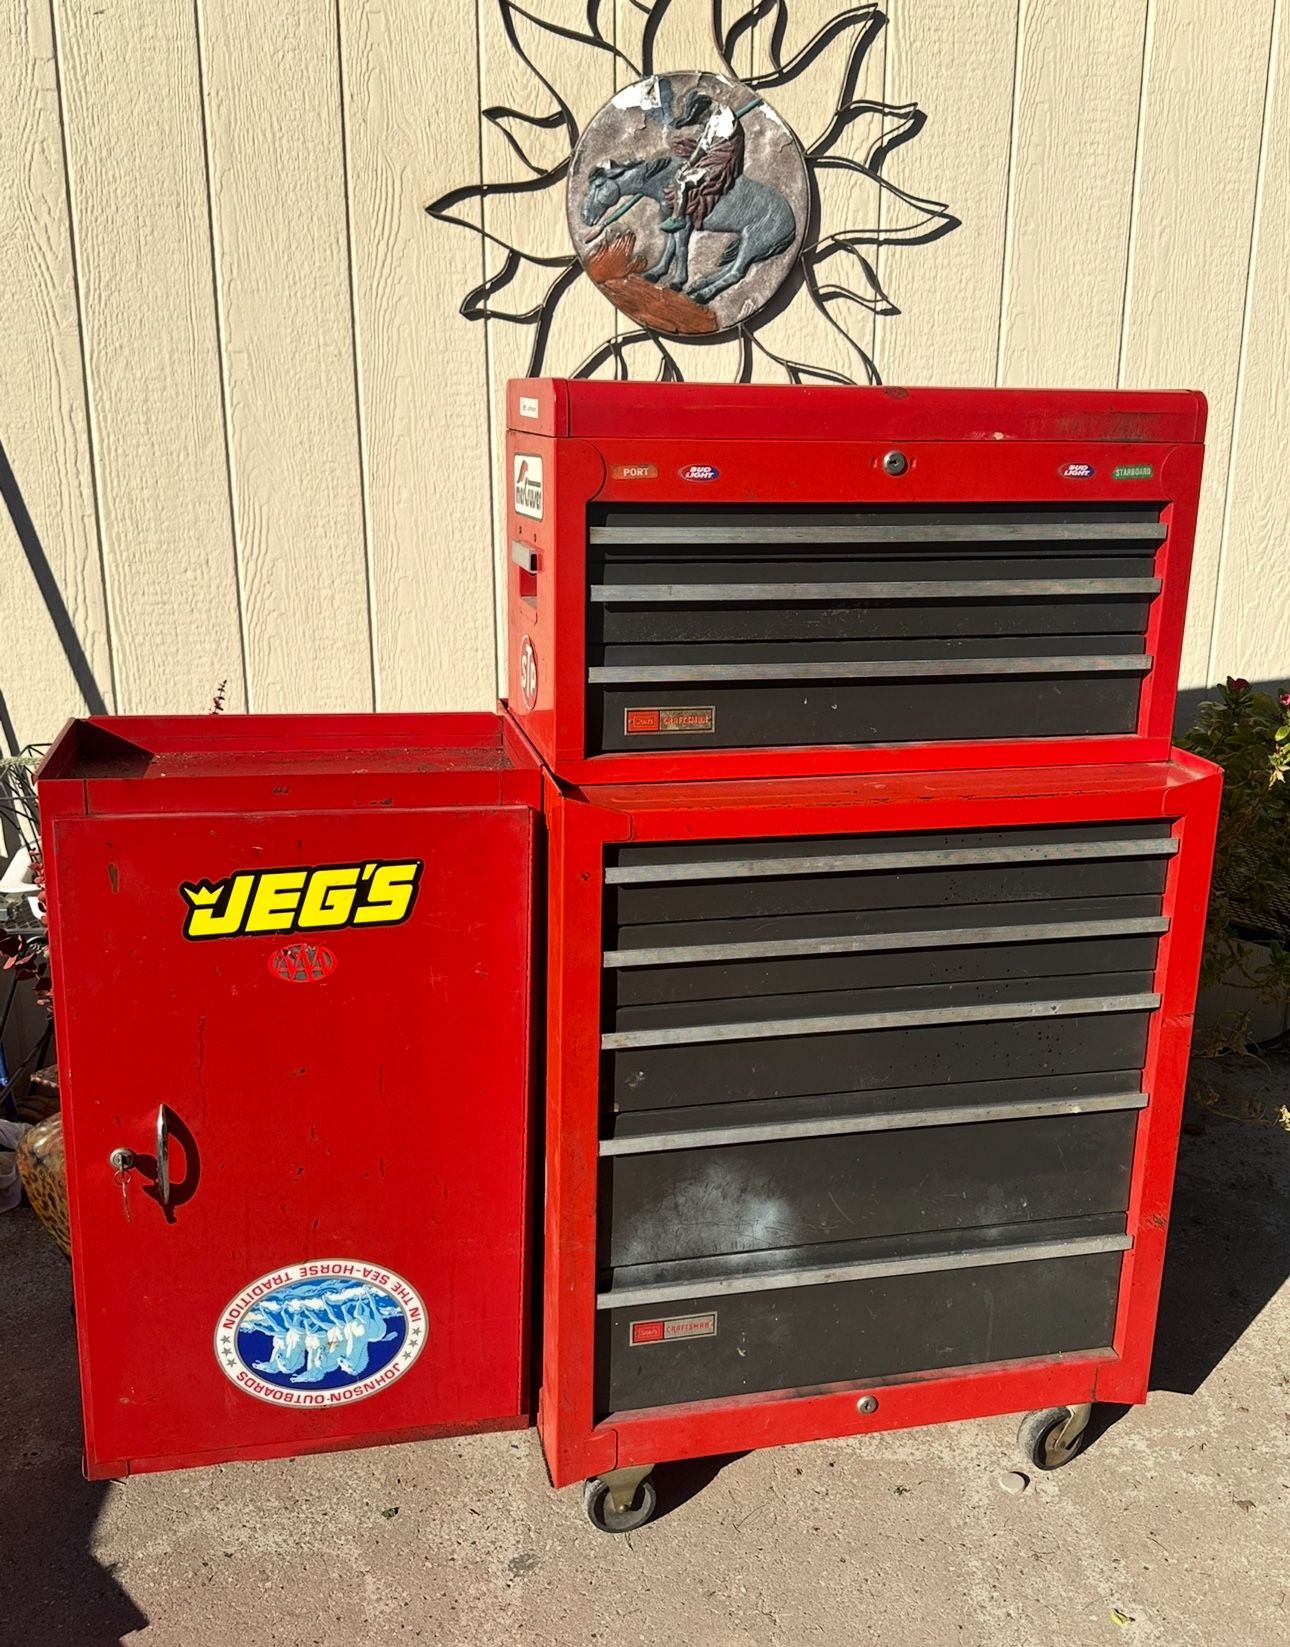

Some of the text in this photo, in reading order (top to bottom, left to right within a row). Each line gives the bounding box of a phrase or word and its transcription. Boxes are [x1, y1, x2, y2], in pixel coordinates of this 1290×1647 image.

[623, 468, 649, 477] PORT
[188, 863, 418, 936] JEG'S
[222, 1276, 293, 1330] TRADITION
[390, 1281, 413, 1306] THE
[408, 1306, 422, 1323] IN
